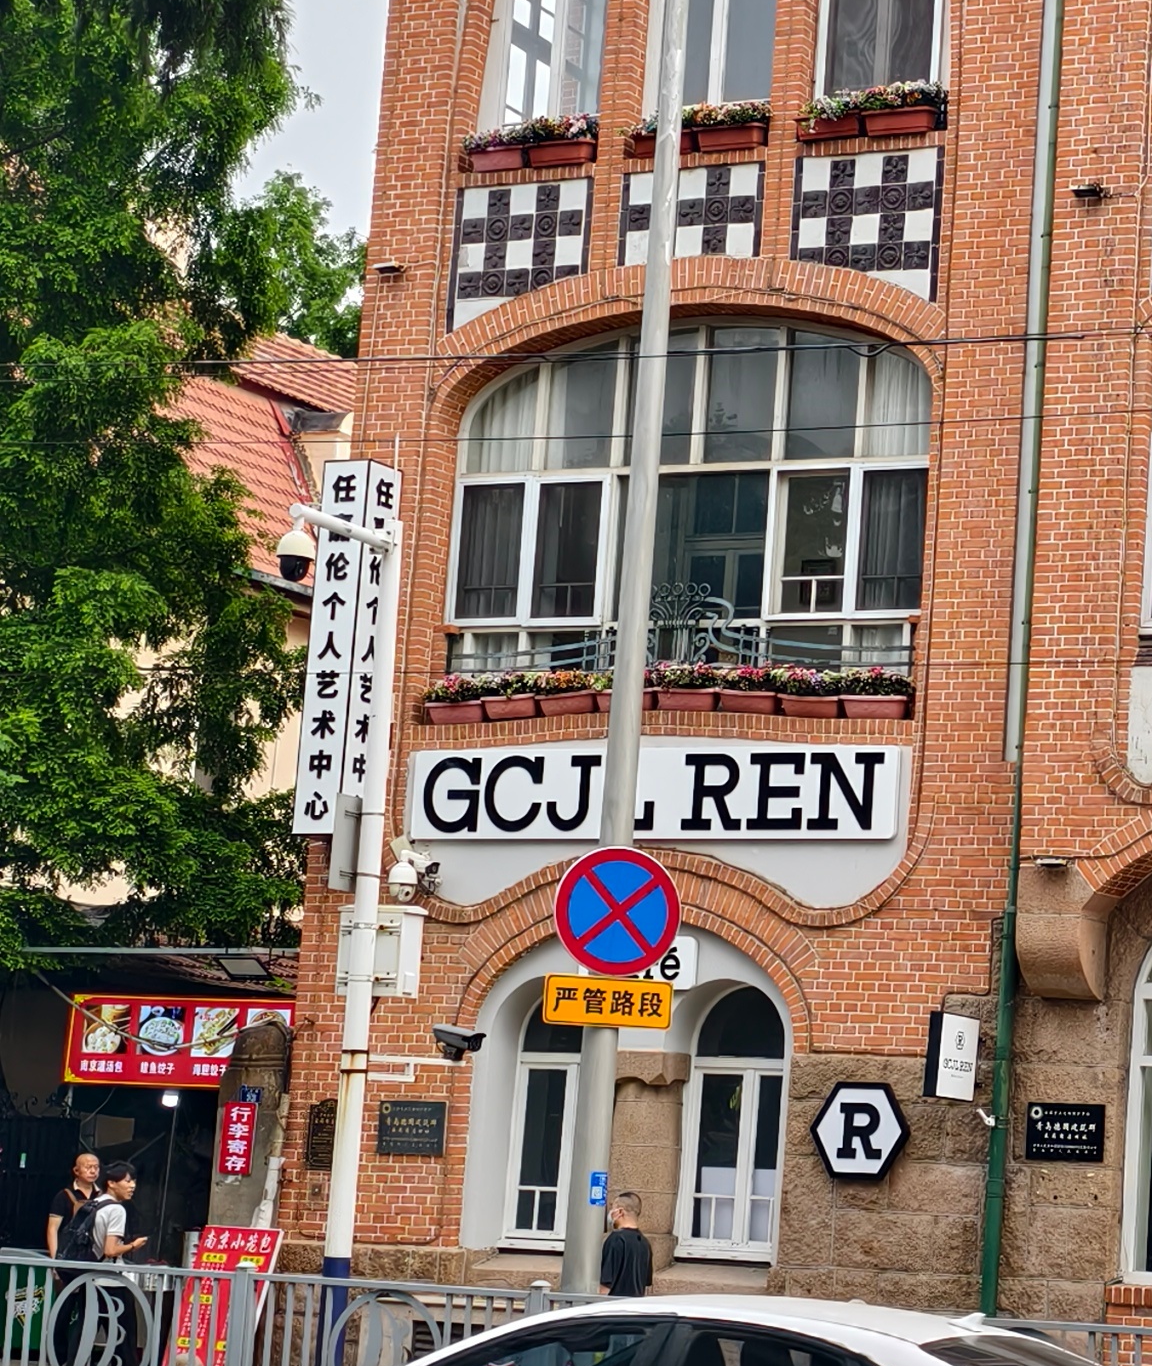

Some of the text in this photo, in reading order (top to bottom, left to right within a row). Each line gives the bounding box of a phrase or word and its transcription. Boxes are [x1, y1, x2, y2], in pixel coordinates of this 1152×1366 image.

[681, 751, 886, 832] REN
[552, 986, 663, 1018] 严管路段
[225, 1106, 252, 1171] 行李寄存
[836, 1102, 882, 1160] R
